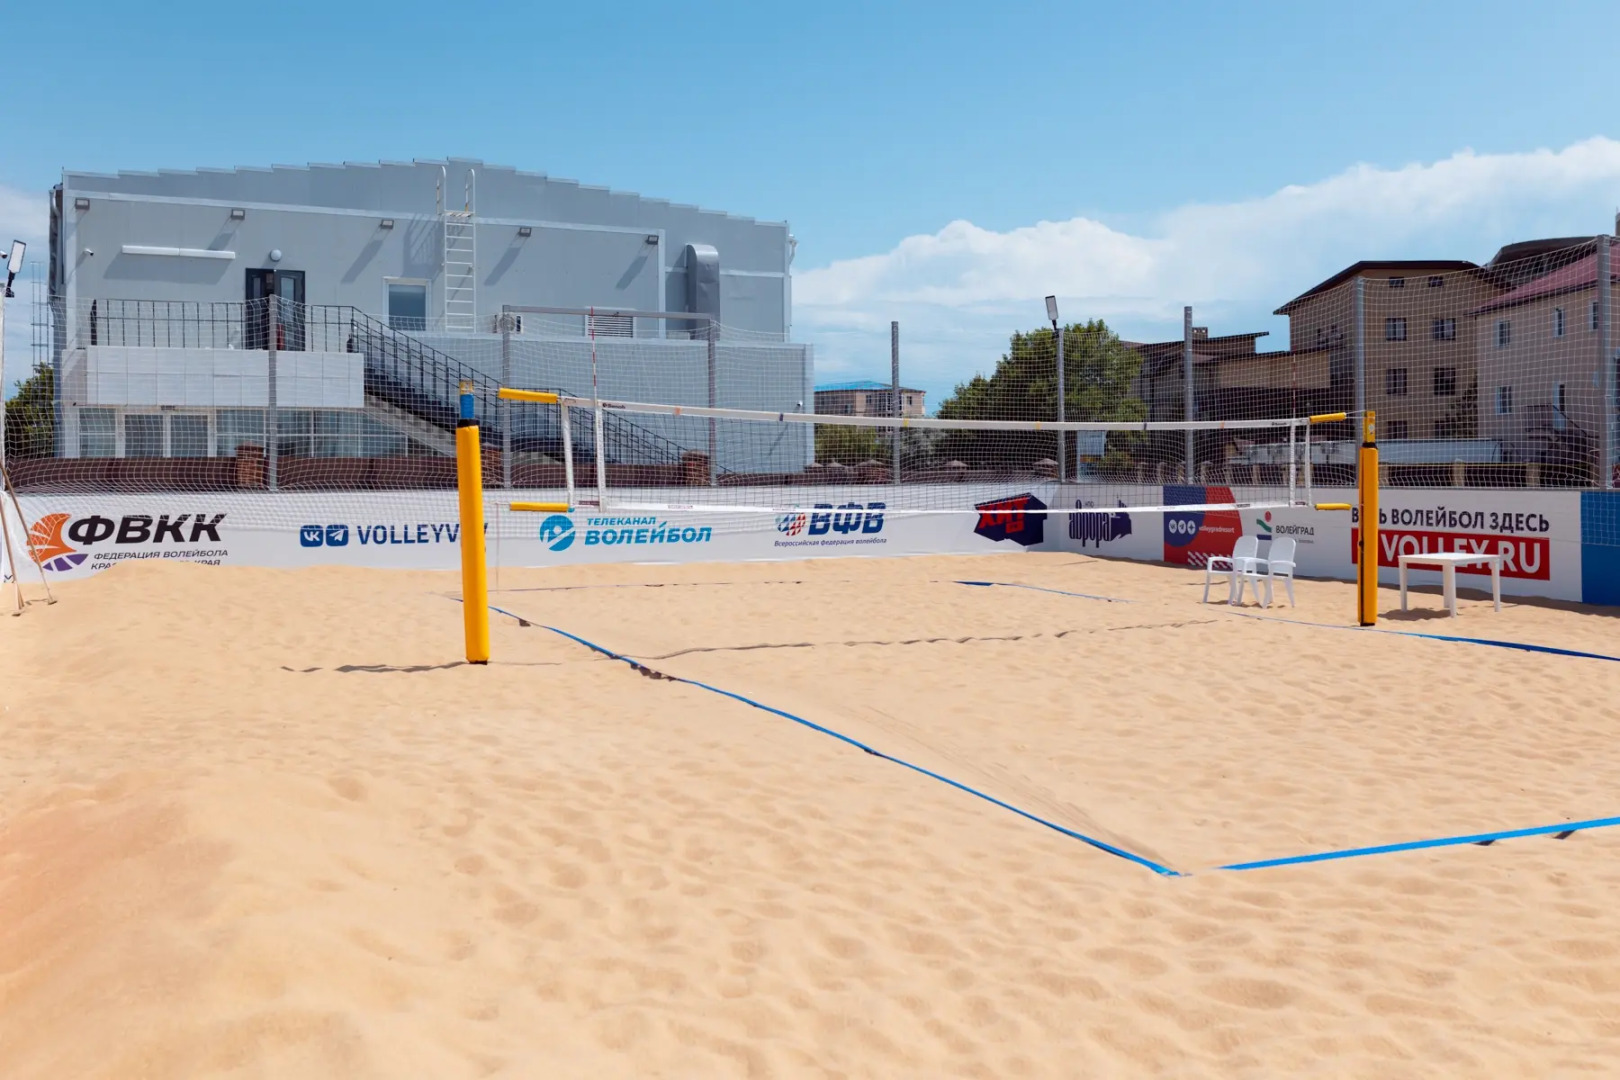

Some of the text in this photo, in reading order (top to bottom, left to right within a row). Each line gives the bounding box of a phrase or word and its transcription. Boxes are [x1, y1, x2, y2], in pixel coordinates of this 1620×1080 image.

[68, 513, 228, 546] ФВКК
[587, 516, 657, 526] ТЕЛЕКАНАЛ
[808, 502, 886, 536] ВФВ
[1275, 524, 1315, 536] ВОЛЕЙГРАД
[1351, 506, 1550, 533] ВЬ ВОЛЕЙБОЛ ЗДЕСЬ
[357, 522, 489, 545] VOLLEYV
[584, 521, 712, 546] ВОЛЕЙБОЛ
[774, 537, 888, 547] Всероссийская федерация волейбола
[93, 549, 229, 561] ФЕДЕРАЦИЯ ВОЛЕЙБОЛА
